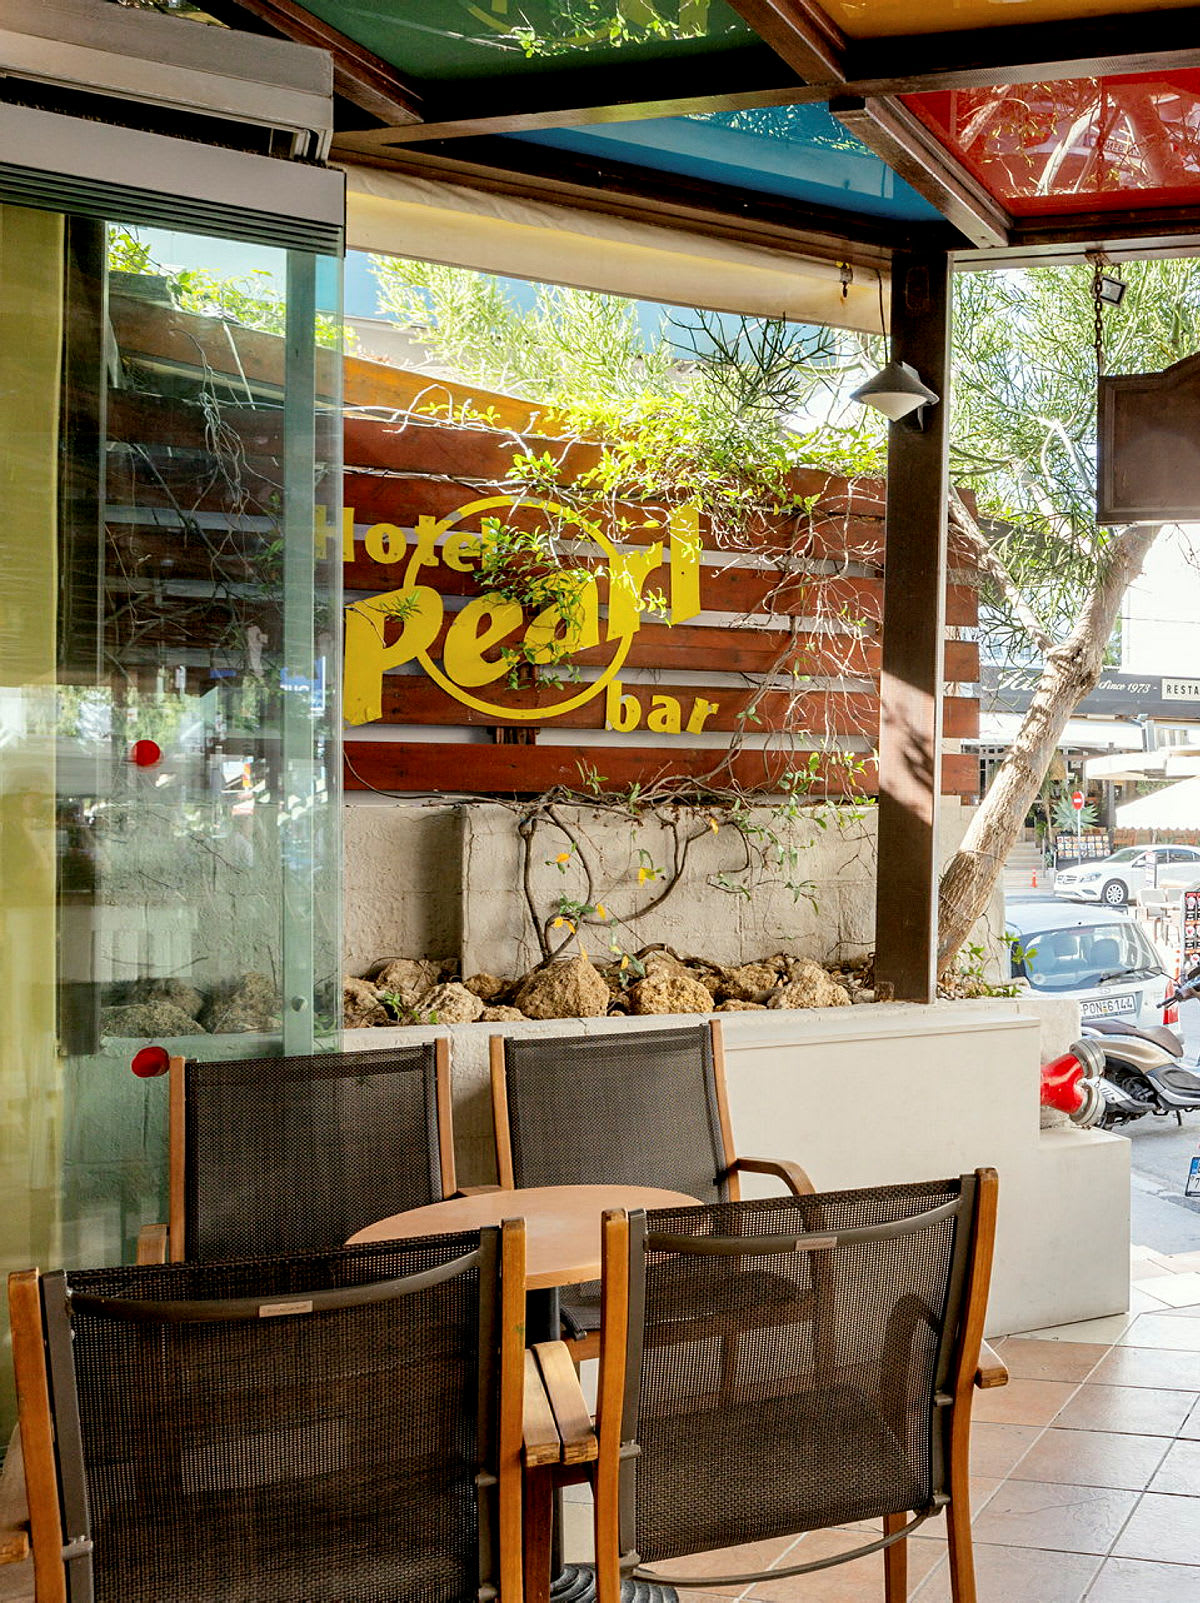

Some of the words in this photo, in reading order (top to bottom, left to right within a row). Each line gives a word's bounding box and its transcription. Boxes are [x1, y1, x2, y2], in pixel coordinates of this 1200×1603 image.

[314, 504, 500, 573] Hotel
[605, 680, 719, 734] bar
[1099, 679, 1125, 691] Since
[1127, 683, 1151, 694] 1973
